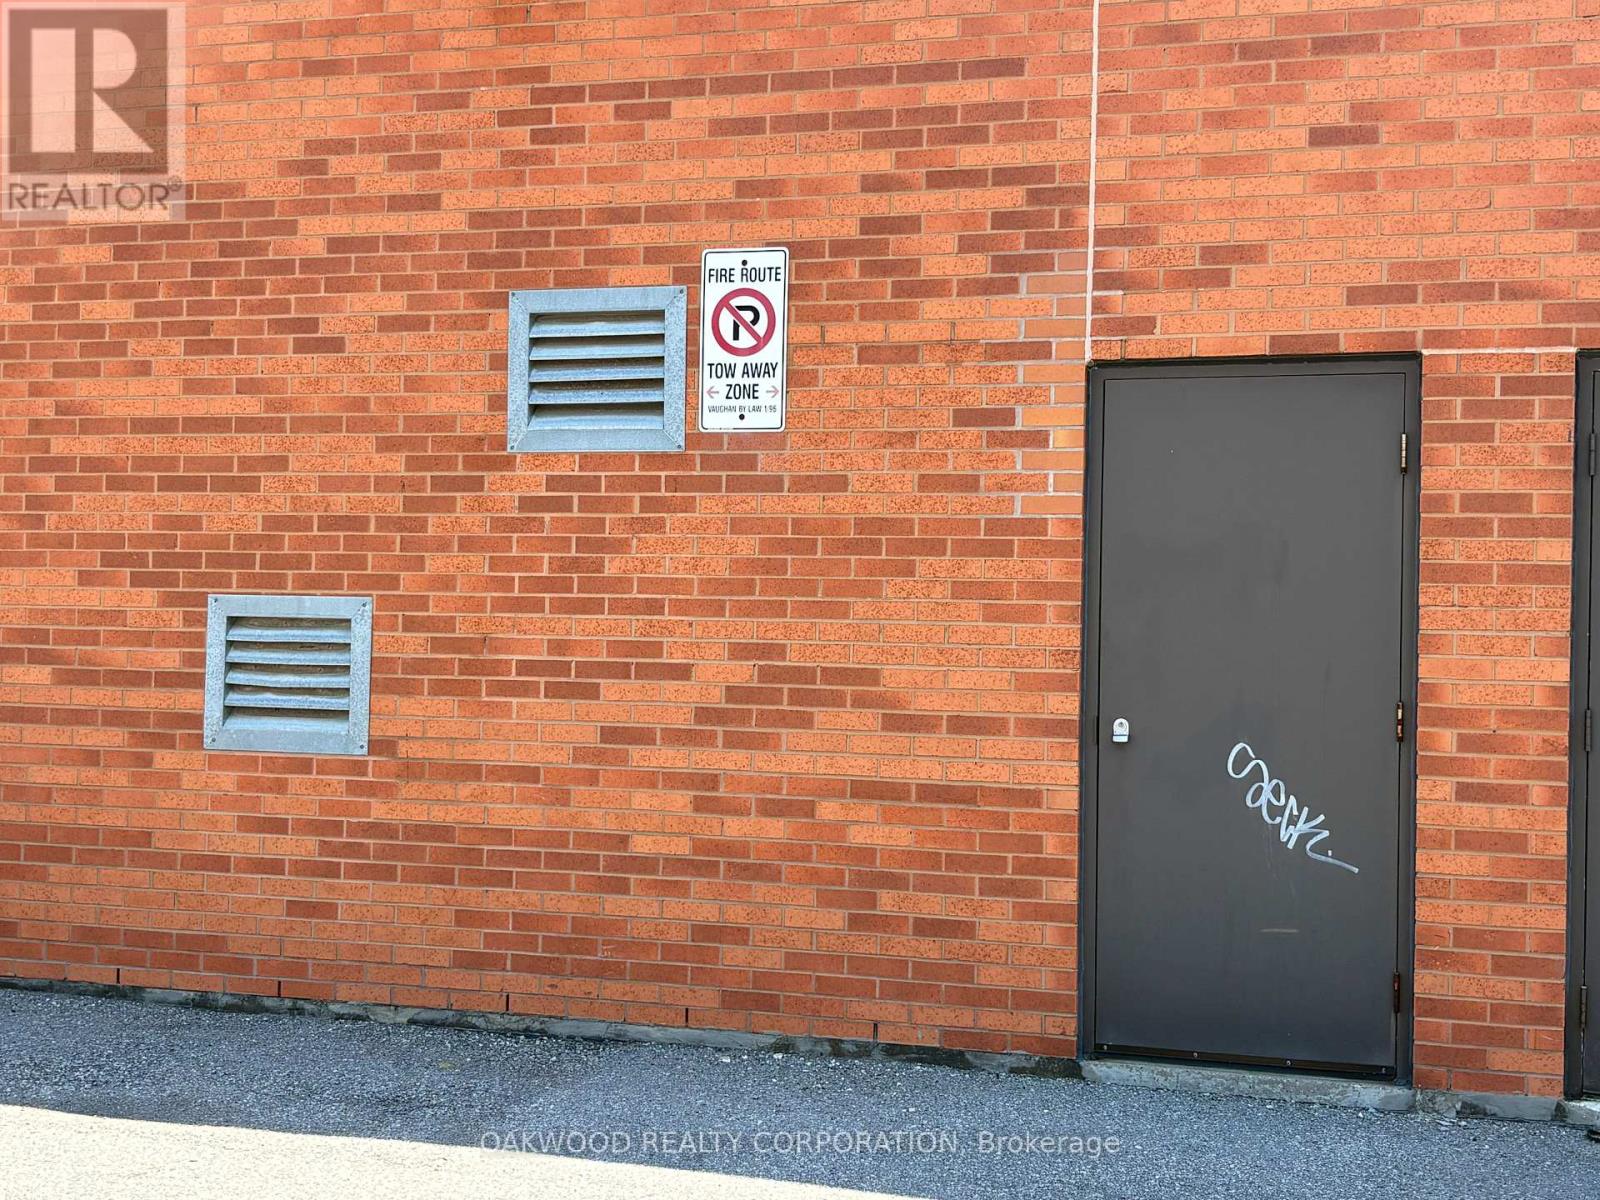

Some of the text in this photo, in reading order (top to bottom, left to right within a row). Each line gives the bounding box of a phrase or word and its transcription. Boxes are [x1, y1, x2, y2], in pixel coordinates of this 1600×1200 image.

[708, 266, 782, 283] FIRE ROUTE
[707, 362, 779, 379] TOW AWAY
[725, 383, 760, 400] ZONE
[707, 405, 737, 413] VAUGHAN
[738, 405, 747, 413] BY
[748, 405, 762, 413] LAW
